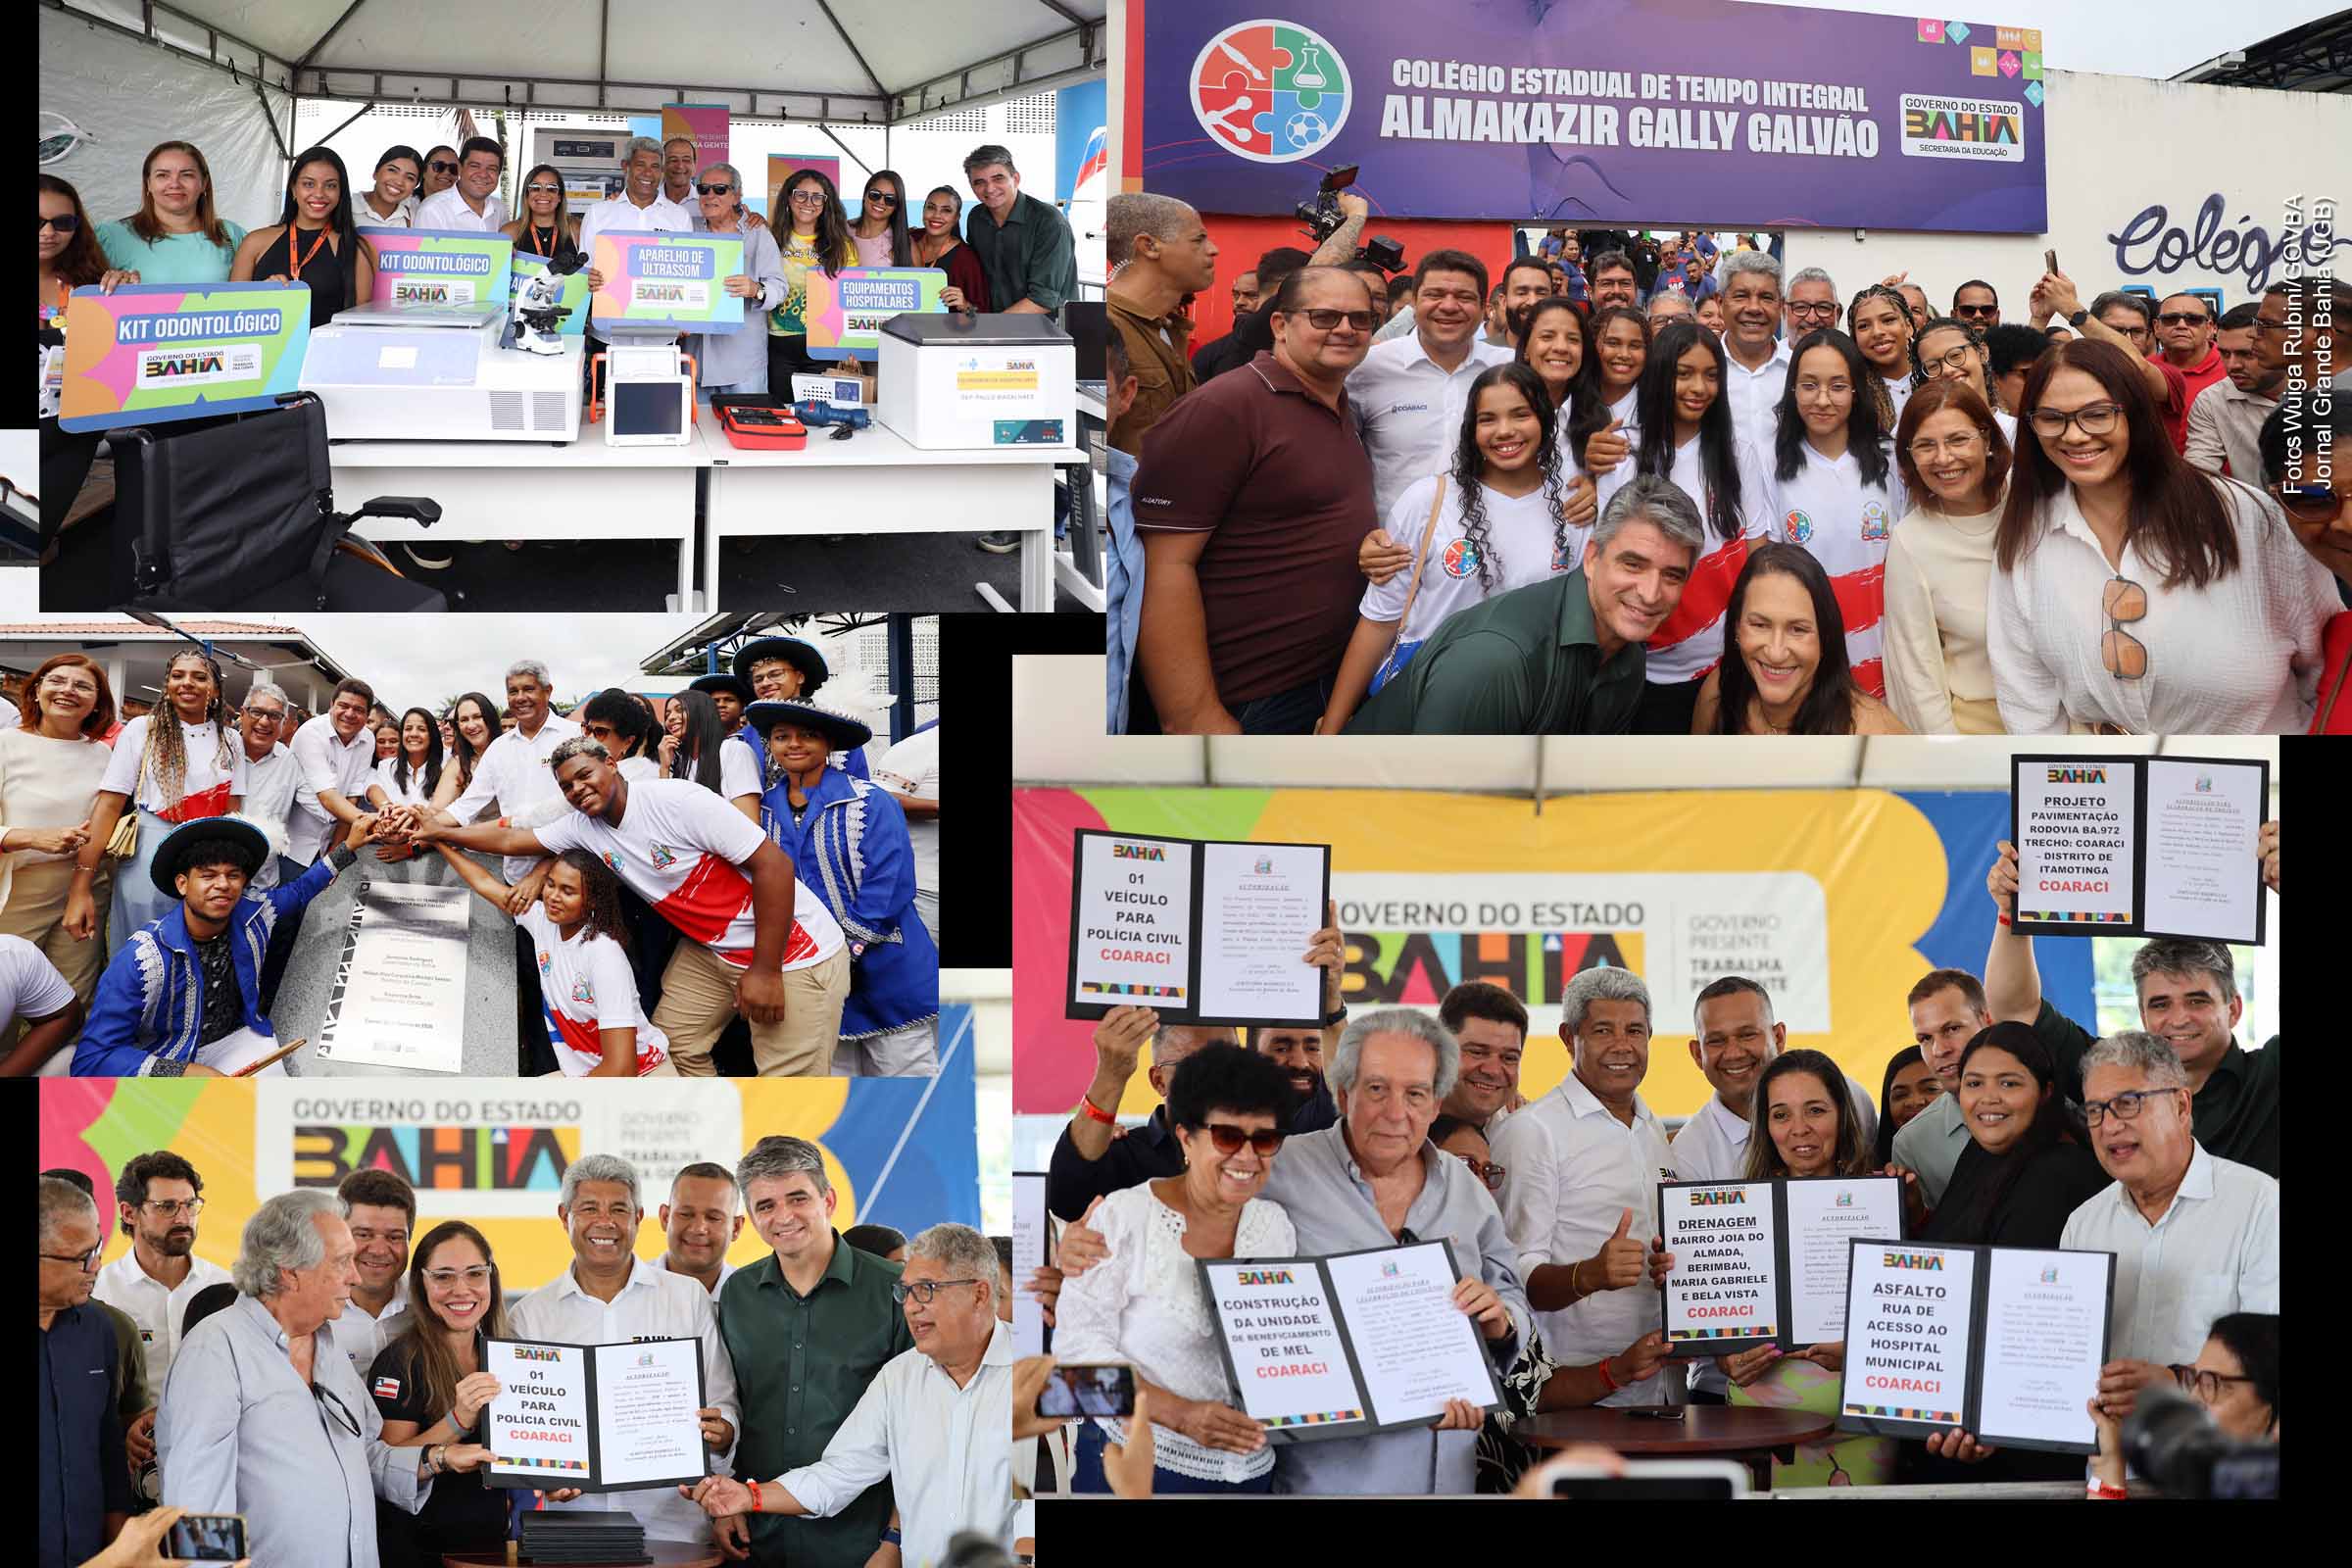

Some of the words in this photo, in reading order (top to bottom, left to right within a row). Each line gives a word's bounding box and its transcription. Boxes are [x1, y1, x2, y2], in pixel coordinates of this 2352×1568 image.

[1392, 59, 1505, 93] COLÉGIO
[1510, 68, 1636, 98] ESTADUAL
[1642, 74, 1671, 101] DE
[1676, 75, 1758, 105] TEMPO
[1764, 80, 1869, 112] INTEGRAL
[1906, 98, 1958, 110] GOVERNO
[1961, 102, 1977, 112] DO
[1980, 104, 2018, 115] ESTADO
[1379, 94, 1620, 146] ALMAKAZIR
[1628, 107, 1740, 152] GALLY
[1747, 113, 1880, 158] GALVÃO
[1906, 109, 2019, 144] BAHIA
[1920, 144, 1960, 154] SECRETARIA
[1973, 147, 2008, 157] EDUCAÇÃO
[380, 254, 400, 270] KIT
[403, 255, 489, 272] ODONTOLÓGICO
[639, 249, 690, 263] APARELHO
[692, 251, 705, 264] DE
[643, 264, 700, 276] ULTRASSOM
[397, 287, 448, 300] BAHIA
[843, 281, 913, 294] EQUIPAMENTOS
[846, 296, 914, 309] HOSPITALARES
[119, 320, 150, 340] KIT
[155, 312, 279, 338] ODONTOLÓGICO
[146, 358, 223, 377] BAHIA
[2048, 769, 2106, 783] BAHIA
[2044, 797, 2106, 807] PROJETO
[2032, 811, 2119, 821] PAVIMENTAÇÃO
[2031, 825, 2079, 834] RODOVIA
[2082, 826, 2120, 835] BA.972
[1113, 845, 1164, 861] BAHIA
[2044, 853, 2095, 861] DISTRITO
[2039, 865, 2109, 874] ITAMOTINGA
[1129, 873, 1145, 884] 01
[2039, 880, 2109, 893] COARACI
[1104, 890, 1168, 906] VEÍCULO
[1116, 911, 1154, 924] PARA
[1339, 903, 1467, 926] OVERNO
[1478, 904, 1519, 926] DO
[1532, 903, 1644, 926] ESTADO
[1087, 928, 1142, 942] POLÍCIA
[1147, 933, 1182, 945] CIVIL
[1101, 949, 1170, 964] COARACI
[294, 1099, 425, 1121] GOVERNO
[436, 1101, 472, 1122] DO
[481, 1101, 582, 1122] ESTADO
[294, 1126, 570, 1189] BAHIA
[1690, 1192, 1745, 1205] BAHIA
[1679, 1216, 1756, 1230] DRENAGEM
[1672, 1236, 1714, 1245] BAIRRO
[1718, 1234, 1744, 1243] JOIA
[1693, 1249, 1743, 1257] ALMADA,
[1688, 1262, 1751, 1272] BERIMBAU,
[1884, 1253, 1943, 1270] BAHIA
[1239, 1270, 1294, 1286] BAHIA
[1672, 1278, 1707, 1287] MARIA
[1711, 1275, 1768, 1285] GABRIELE
[1692, 1292, 1721, 1300] BELA
[1725, 1290, 1758, 1298] VISTA
[1873, 1283, 1946, 1298] ASFALTO
[1224, 1296, 1320, 1310] CONSTRUÇÃO
[1883, 1303, 1911, 1315] RUA
[1916, 1305, 1935, 1316] DE
[1688, 1305, 1753, 1318] COARACI
[1234, 1318, 1253, 1329] DA
[1257, 1314, 1321, 1327] UNIDADE
[1867, 1320, 1923, 1334] ACESSO
[1928, 1325, 1947, 1336] AO
[1248, 1330, 1331, 1342] BENEFICIAMENTO
[1260, 1348, 1279, 1357] DE
[1284, 1345, 1313, 1356] MEL
[1871, 1339, 1941, 1353] HOSPITAL
[514, 1348, 561, 1362] BAHIA
[1256, 1362, 1328, 1378] COARACI
[1866, 1356, 1943, 1372] MUNICIPAL
[530, 1371, 544, 1380] 01
[510, 1384, 566, 1396] VEÍCULO
[1866, 1376, 1940, 1393] COARACI
[521, 1400, 556, 1411] PARA
[497, 1414, 546, 1425] POLÍCIA
[550, 1418, 581, 1427] CIVIL
[510, 1430, 572, 1443] COARACI
